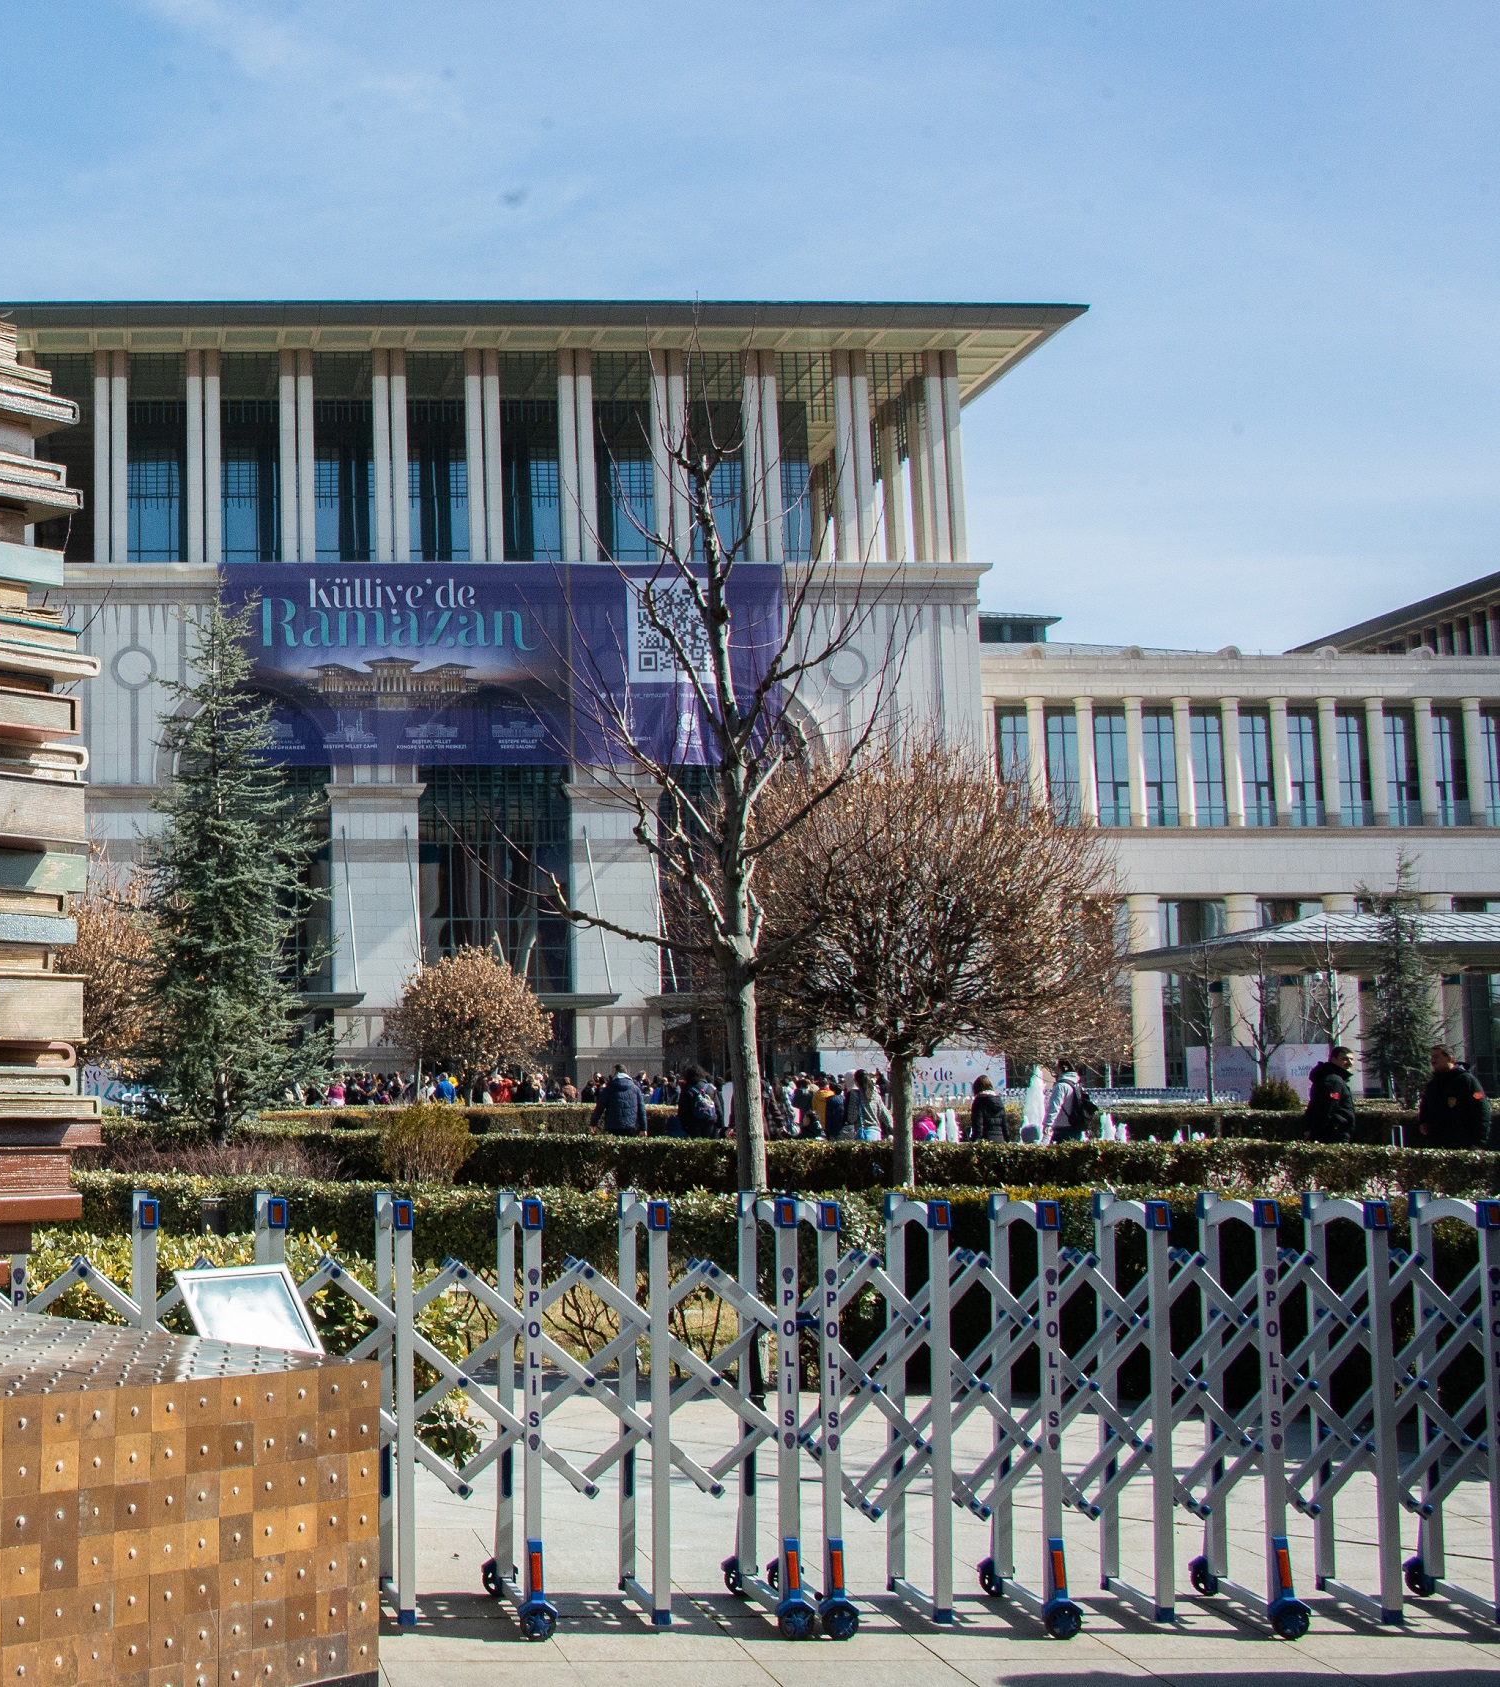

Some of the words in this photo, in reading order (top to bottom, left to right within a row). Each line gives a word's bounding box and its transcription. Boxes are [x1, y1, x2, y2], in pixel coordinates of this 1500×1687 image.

[261, 597, 542, 651] Ramazan
[309, 577, 476, 615] Külliye'de
[528, 1290, 541, 1429] POLİS
[783, 1290, 796, 1428] POLİS
[825, 1291, 840, 1429] POLİS
[1046, 1290, 1060, 1429] POLİS
[1265, 1290, 1281, 1429] POLİS
